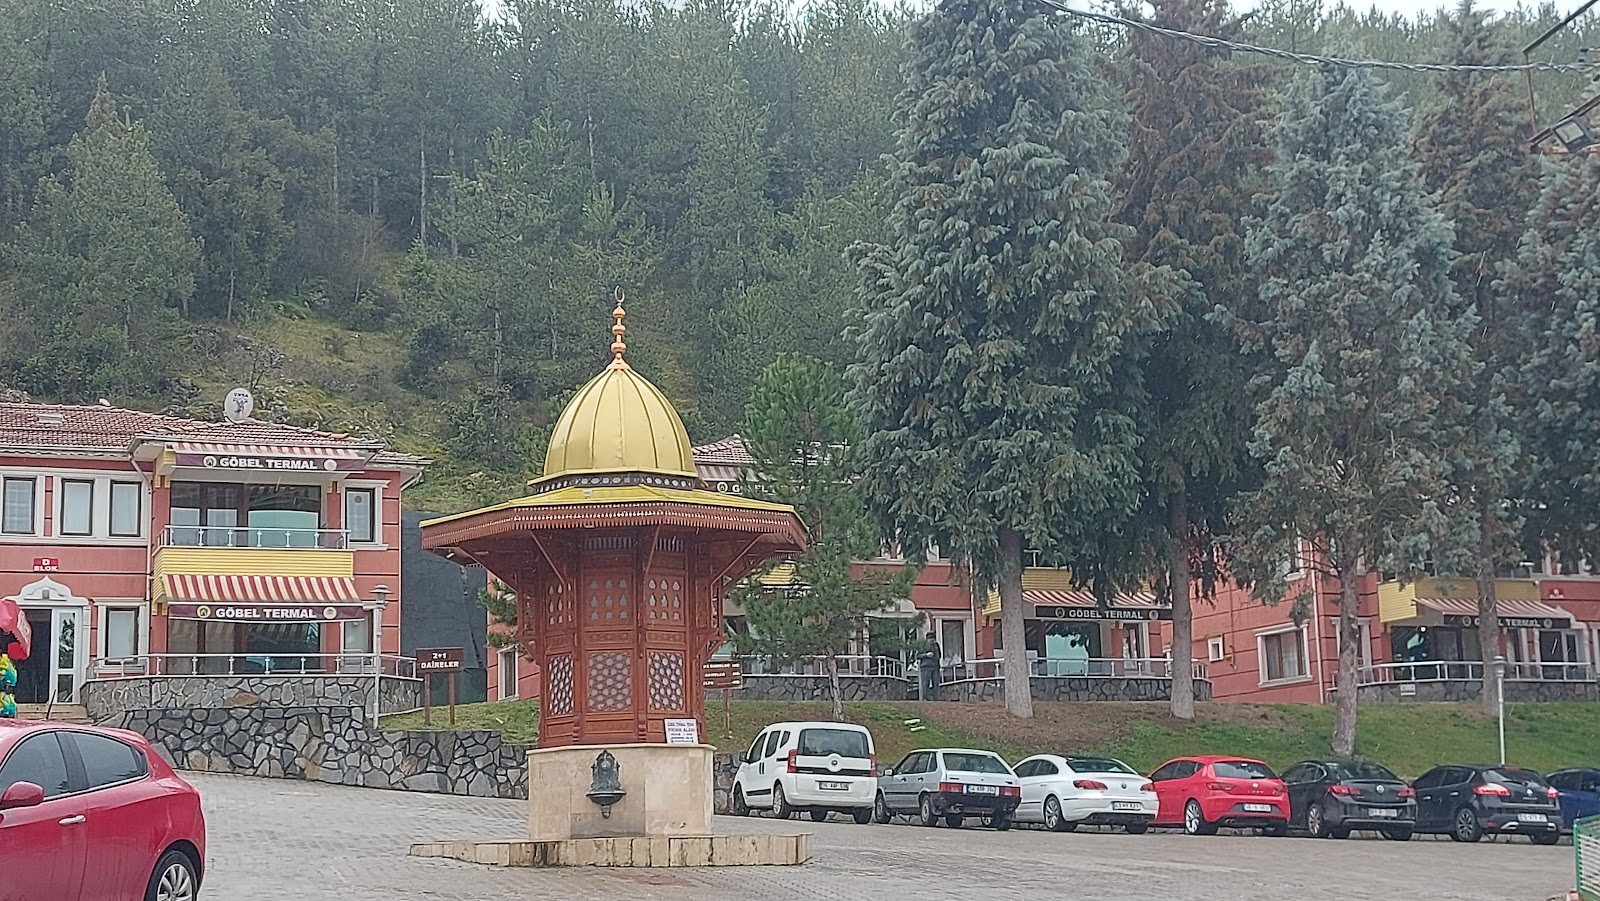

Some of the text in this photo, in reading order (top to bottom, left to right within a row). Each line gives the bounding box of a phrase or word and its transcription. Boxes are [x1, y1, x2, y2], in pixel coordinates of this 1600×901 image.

[220, 456, 318, 470] GÖBEL TERMAL
[216, 606, 317, 618] GÖBEL TERMAL
[1104, 610, 1144, 620] TERMAL
[420, 660, 460, 668] DAİRELER
